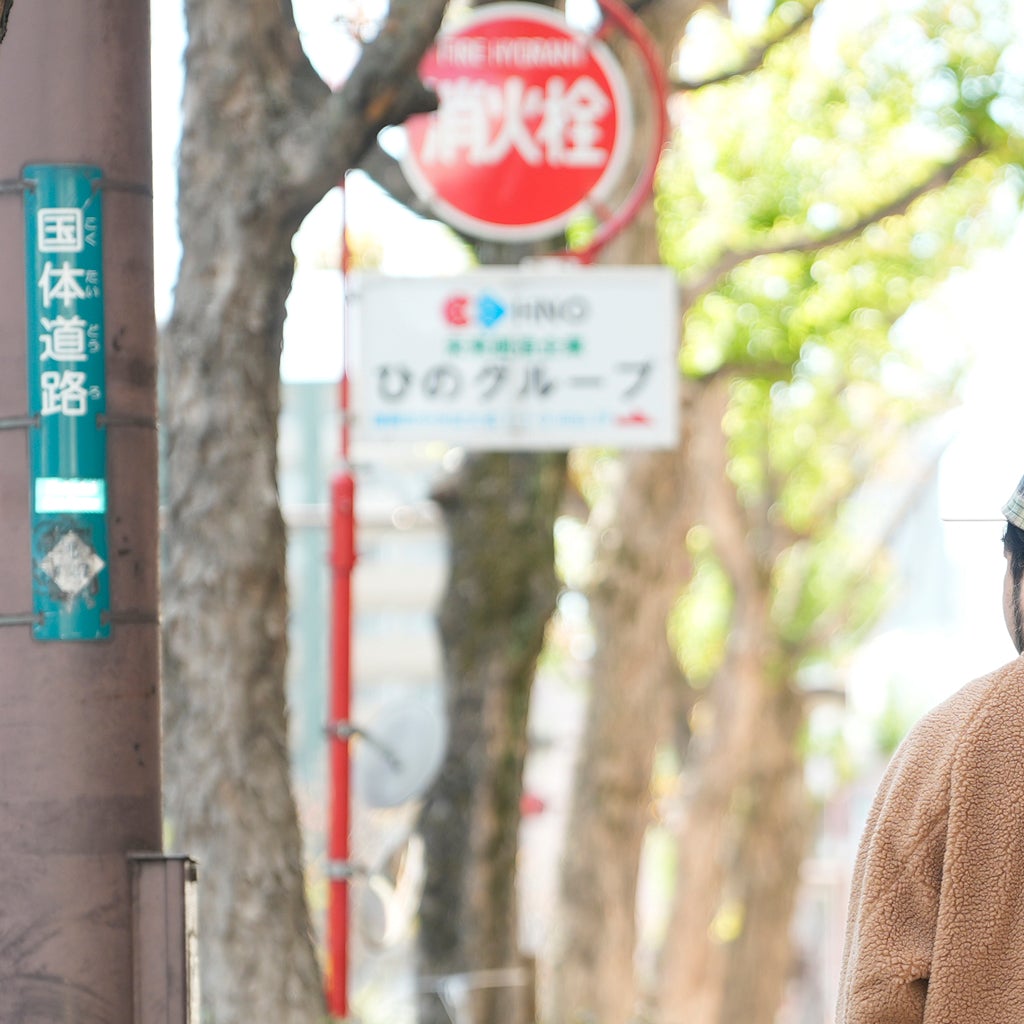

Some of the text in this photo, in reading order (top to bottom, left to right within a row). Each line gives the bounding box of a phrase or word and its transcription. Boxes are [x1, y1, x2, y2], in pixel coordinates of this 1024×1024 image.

[421, 76, 609, 167] 消火栓
[37, 207, 88, 416] 国体道路
[376, 362, 654, 402] ひのグループ
